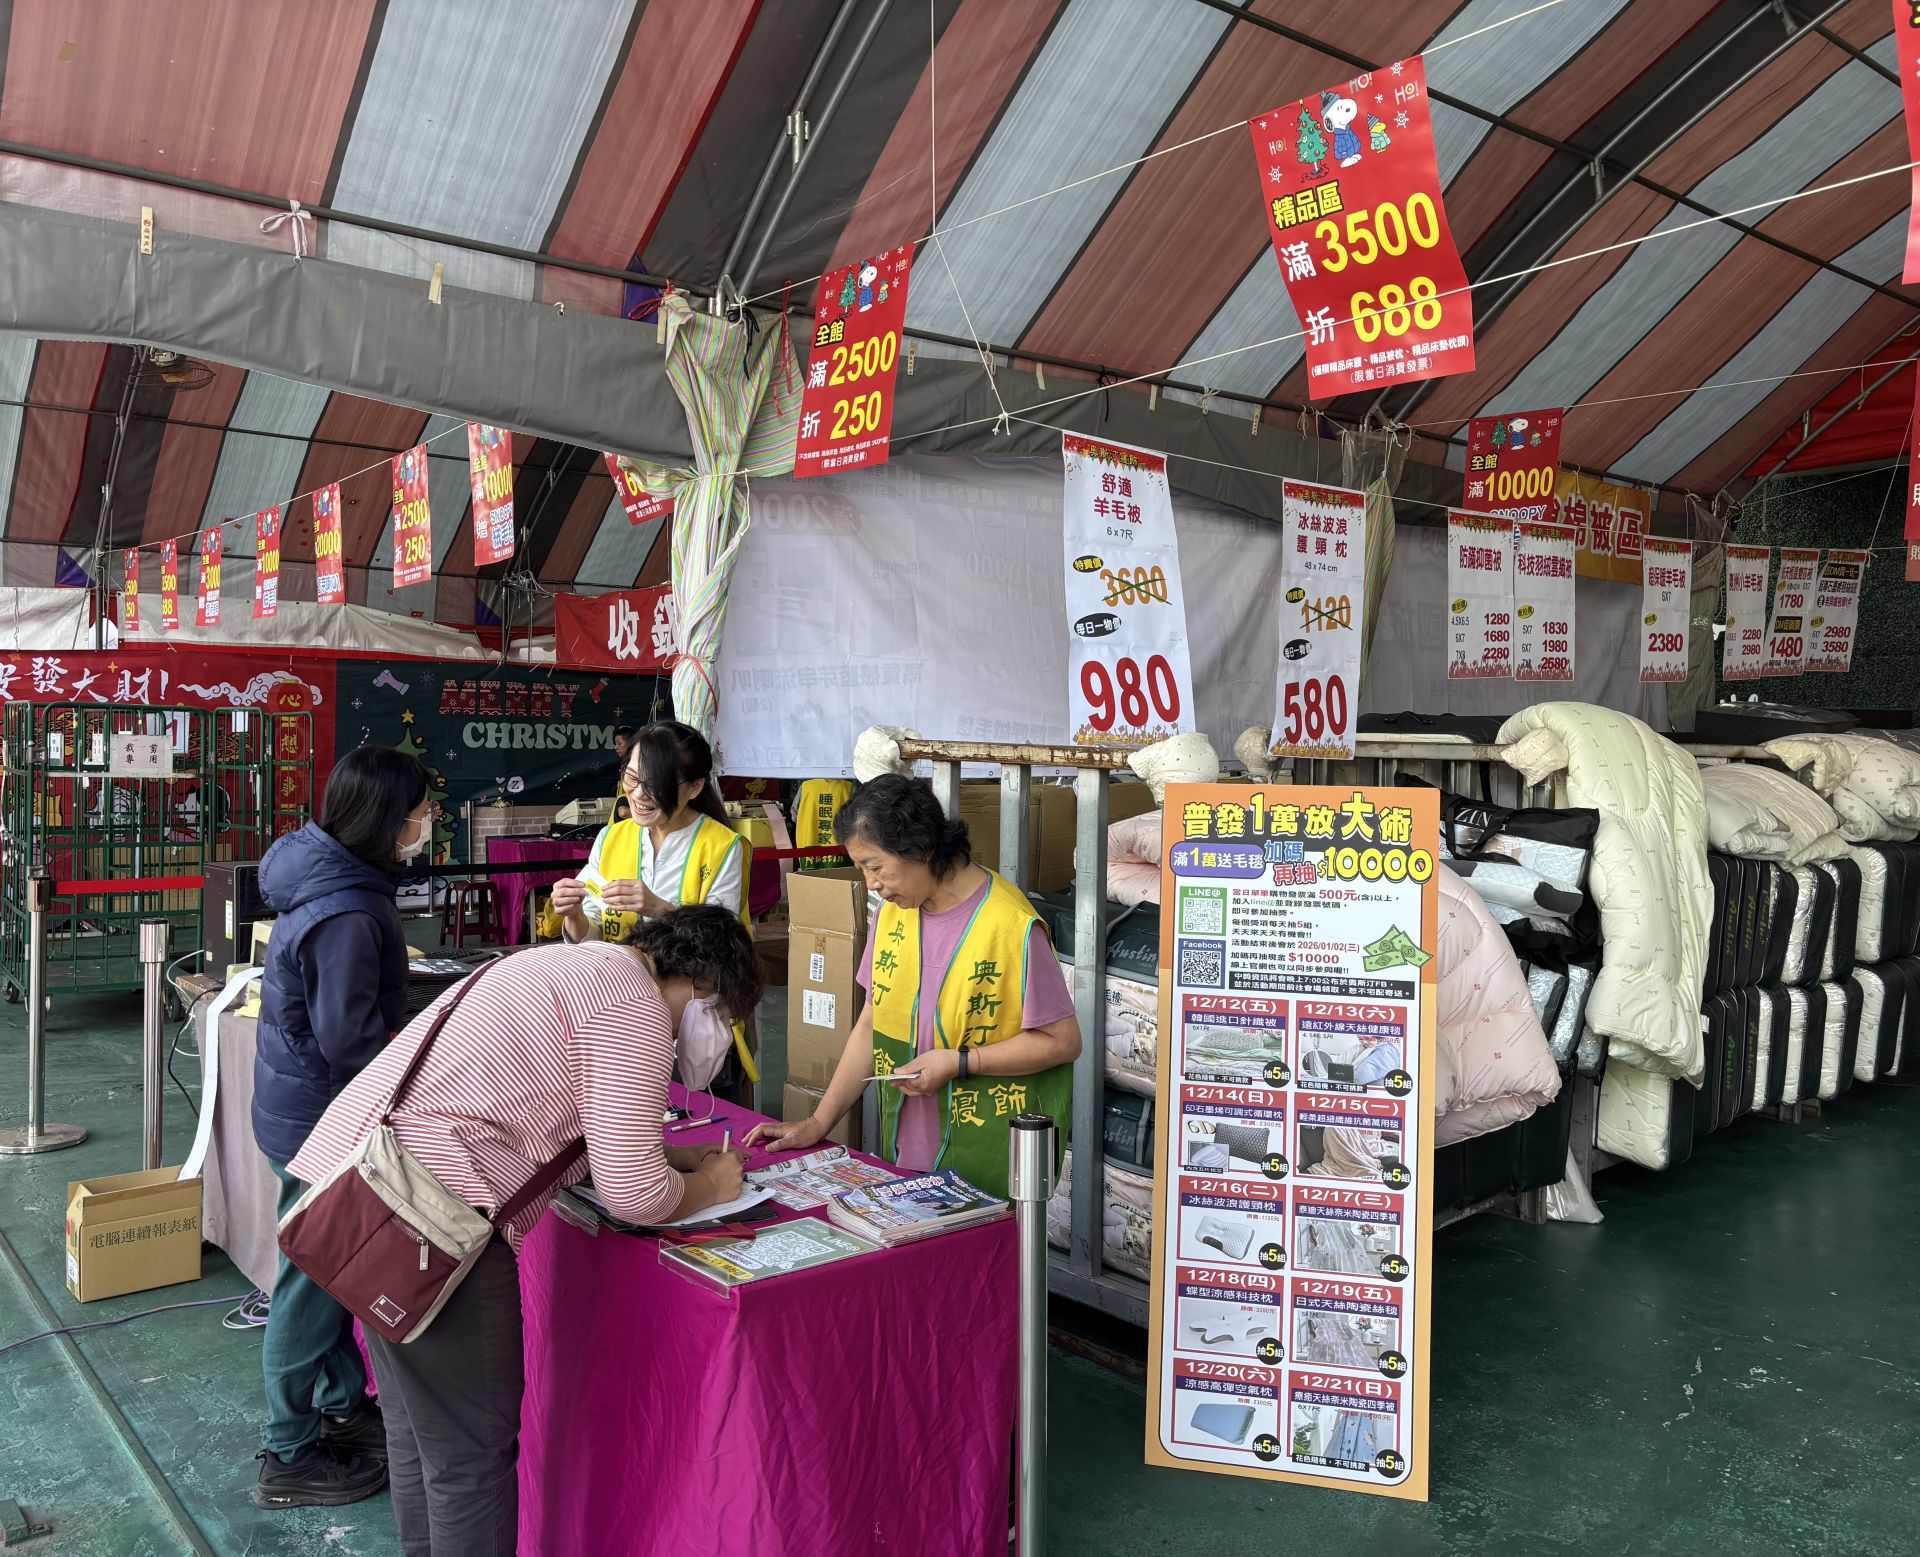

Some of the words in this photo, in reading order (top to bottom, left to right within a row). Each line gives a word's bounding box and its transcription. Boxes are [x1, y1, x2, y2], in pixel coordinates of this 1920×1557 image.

[1273, 181, 1343, 230] 精品區
[1280, 241, 1317, 282] 滿
[1315, 192, 1440, 273] 3500
[1306, 306, 1335, 346] 折
[1351, 277, 1442, 343] 688
[815, 319, 845, 347] 全館
[807, 360, 828, 389] 滿
[829, 331, 896, 386] 2500
[1351, 358, 1433, 384] (限當日消費發票)
[801, 411, 821, 439] 折
[830, 391, 881, 439] 250
[1470, 454, 1498, 470] 全館
[484, 463, 512, 502] 10000
[1101, 472, 1132, 497] 舒適
[1468, 481, 1484, 498] 滿
[1485, 466, 1554, 501] 10000
[402, 498, 427, 529] 2500
[1094, 496, 1142, 524] 羊毛被
[1298, 512, 1348, 536] 冰絲波浪
[405, 535, 425, 564] 250
[1304, 561, 1312, 571] 48
[1318, 562, 1326, 572] 74
[1327, 564, 1338, 573] cm
[1100, 565, 1168, 607] 3600
[1662, 591, 1671, 601] 6X7
[1780, 594, 1804, 609] 1780
[1301, 594, 1351, 633] 1120
[1484, 613, 1510, 626] 1280
[1484, 630, 1510, 642] 1680
[1522, 625, 1533, 635] 5X7
[1542, 621, 1568, 635] 1830
[1742, 628, 1762, 640] 2280
[1824, 626, 1851, 638] 2980
[1521, 643, 1532, 653] 6X7
[1542, 640, 1568, 653] 1980
[1648, 633, 1683, 653] 2380
[1742, 644, 1760, 656] 2980
[1769, 636, 1803, 657] 1480
[1822, 641, 1848, 653] 3580
[1482, 647, 1510, 660] 2280
[1541, 657, 1568, 670] 2580
[439, 679, 580, 718] MERRY
[1080, 654, 1180, 732] 980
[1284, 675, 1347, 744] 580
[463, 721, 620, 750] CHRISTM
[818, 793, 833, 845] 睡眠專家
[1183, 791, 1411, 844] 普發1萬放大術
[1173, 847, 1264, 870] 滿1萬送毛毯
[1265, 841, 1304, 862] 加碼
[1274, 862, 1317, 885] 再抽
[1317, 847, 1433, 883] $10000
[1188, 888, 1221, 897] LINE@
[1108, 940, 1157, 961] Austin
[1183, 941, 1222, 949] Facebook
[1288, 953, 1339, 964] $10000
[967, 960, 1003, 1047] 奧斯汀
[1189, 997, 1277, 1014] 12/12(五)
[1304, 1003, 1395, 1021] 12/13(六)
[1191, 1013, 1277, 1027] 韓國進口針織被
[1302, 1020, 1401, 1035] 遠紅外線天絲健康毯
[1264, 1067, 1290, 1080] 抽5組
[1384, 1075, 1411, 1089] 抽5組
[950, 1082, 1027, 1128] 寢飾
[1185, 1087, 1274, 1105] 12/14(日)
[1185, 1104, 1283, 1119] 6D石墨烯可調式循環枕
[1307, 1096, 1399, 1116] 12/15(一)
[1261, 1159, 1288, 1172] 抽5組
[1383, 1169, 1410, 1183] 抽5組
[1190, 1180, 1278, 1199] 12/16(二)
[1300, 1188, 1391, 1208] 12/17(三)
[1189, 1195, 1276, 1212] 冰絲波浪護頸枕
[90, 1215, 198, 1249] 電腦連續報表紙
[1260, 1249, 1286, 1262] 抽5組
[1381, 1260, 1409, 1274] 抽5組
[1187, 1269, 1276, 1290] 12/18(四)
[1186, 1286, 1273, 1303] 蝶型涼感科技枕
[1300, 1282, 1391, 1302] 12/19(五)
[1257, 1344, 1284, 1357] 抽5組
[1186, 1362, 1275, 1383] 12/20(六)
[1379, 1357, 1407, 1371] 抽5組
[1185, 1378, 1272, 1397] 涼感高彈空氣枕
[1300, 1375, 1392, 1398] 12/21(日)
[1253, 1440, 1280, 1454] 抽5組
[1376, 1456, 1404, 1471] 抽5組
